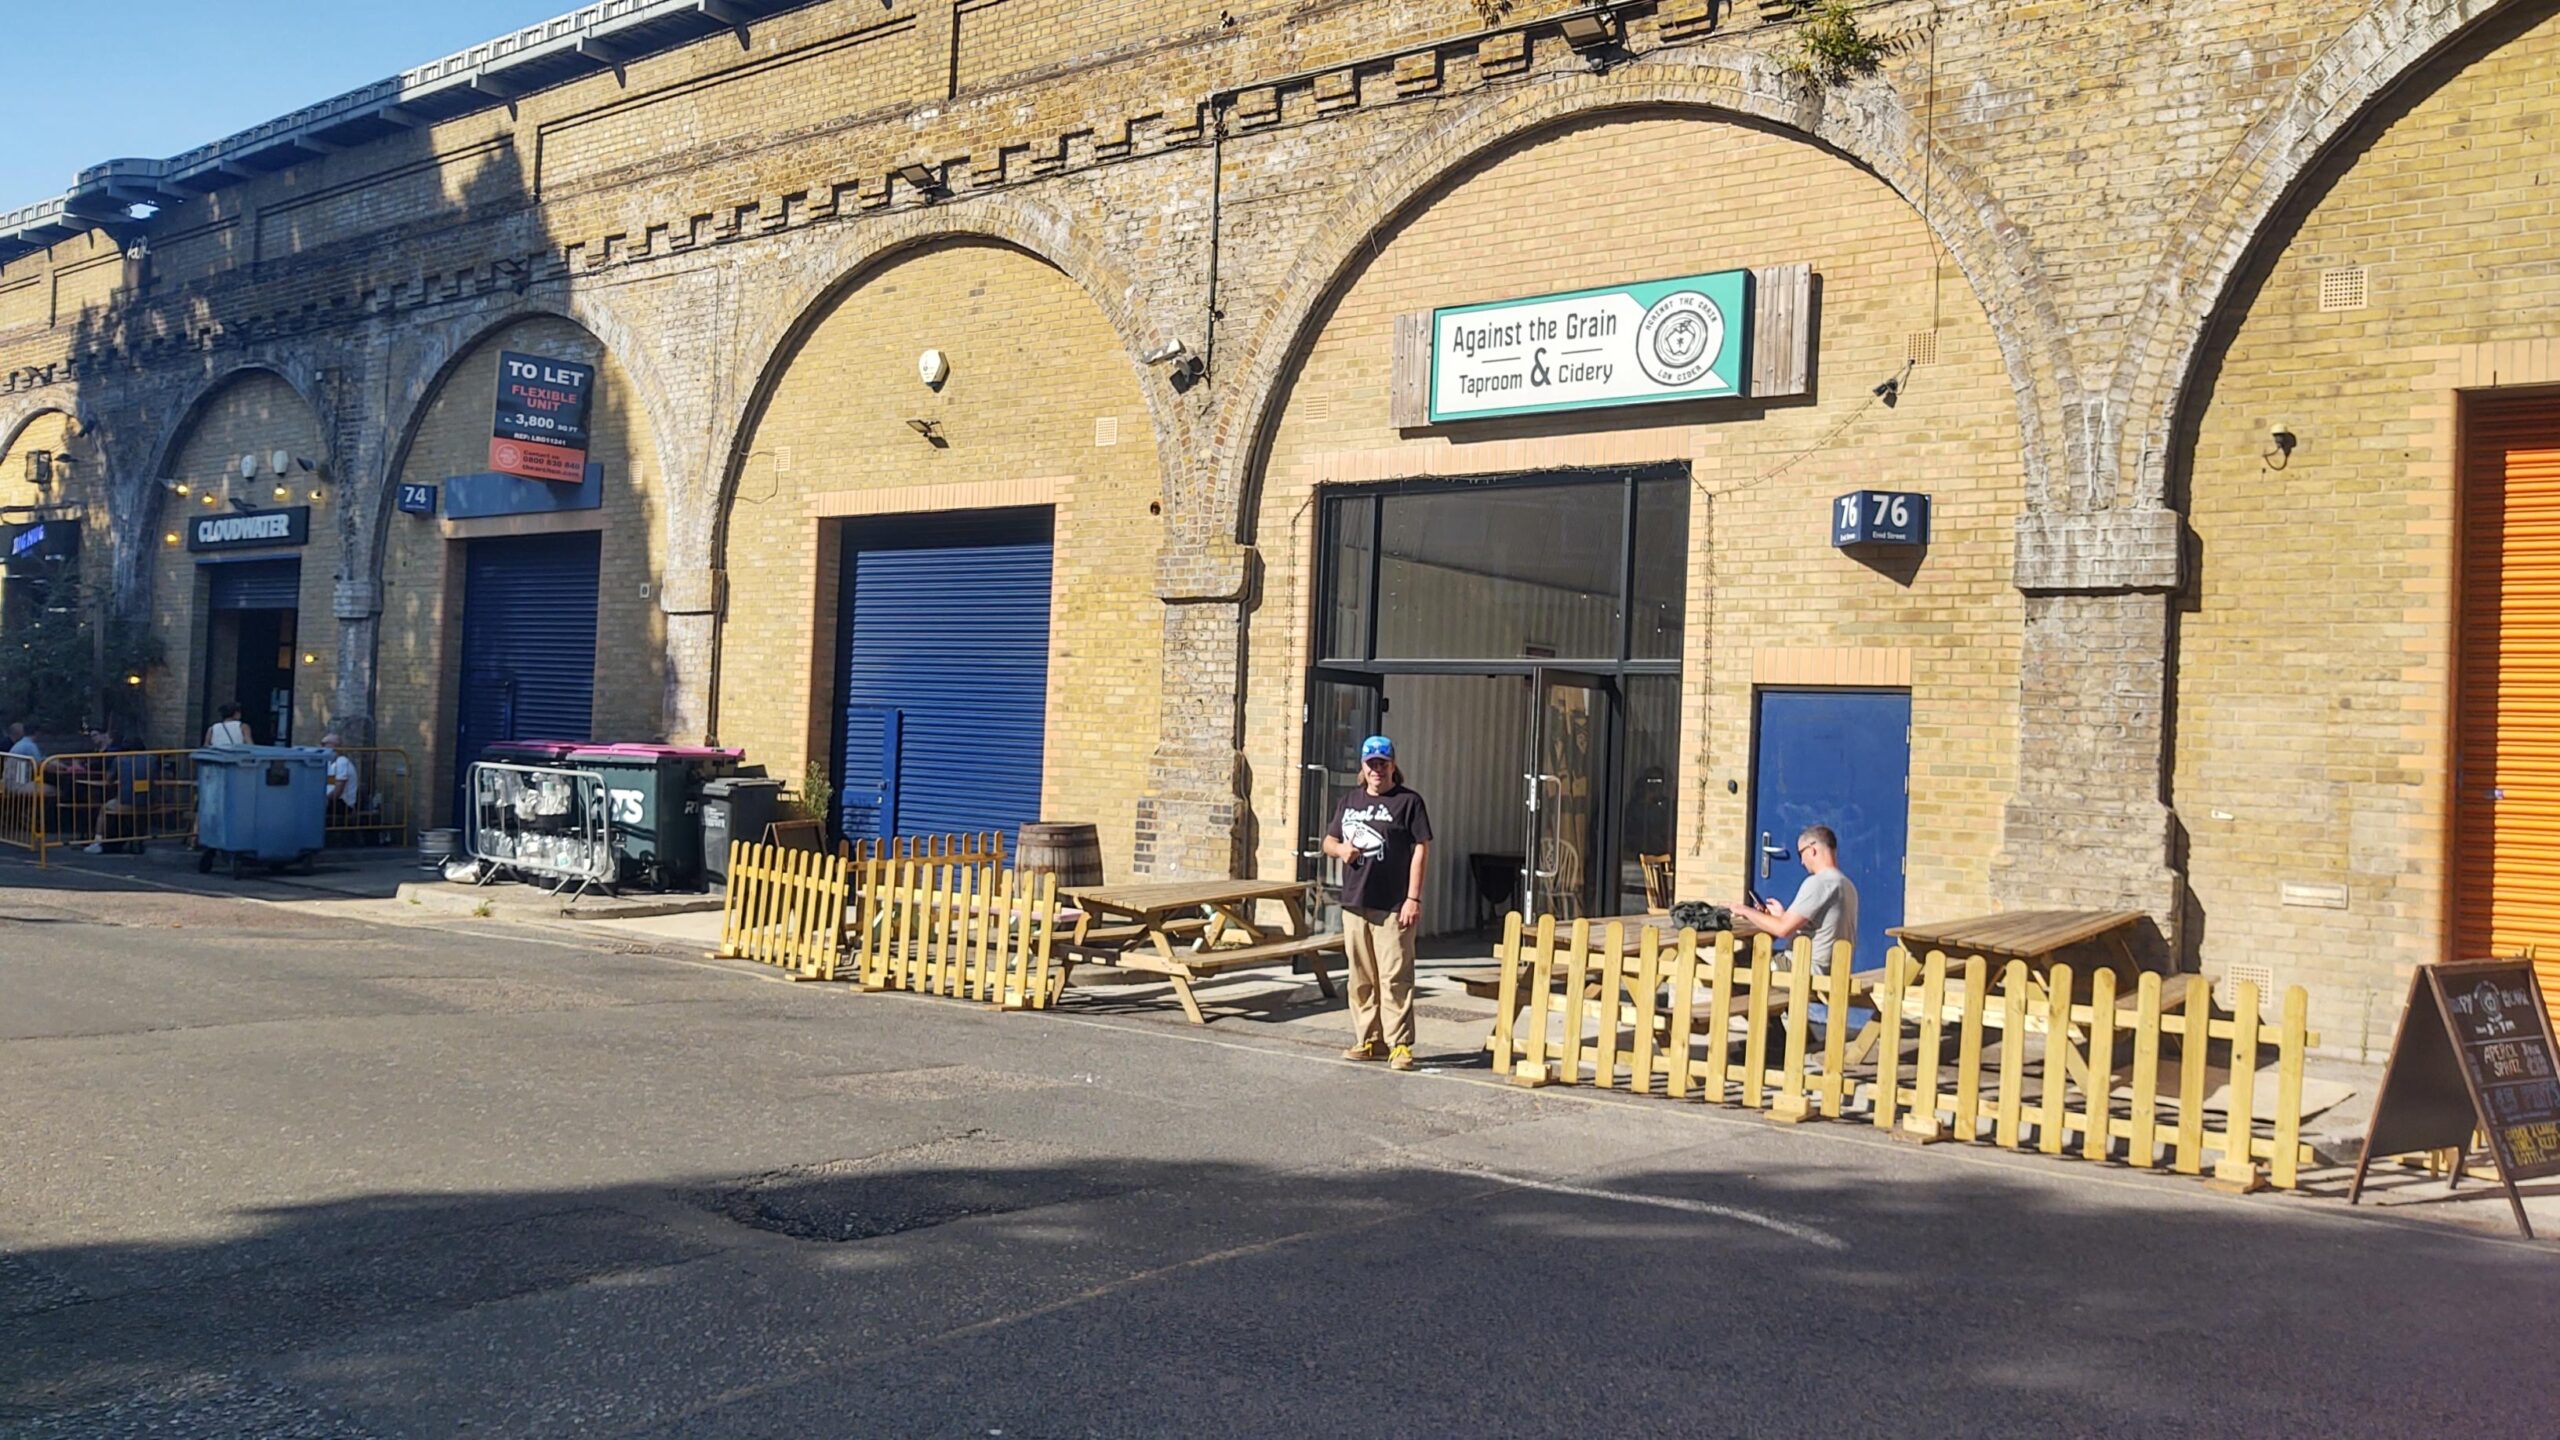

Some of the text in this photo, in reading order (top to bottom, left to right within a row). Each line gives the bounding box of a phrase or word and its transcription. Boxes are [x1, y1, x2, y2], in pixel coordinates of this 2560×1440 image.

[1453, 309, 1617, 358] Against the Grain
[508, 360, 585, 387] TO LET
[1459, 347, 1613, 398] Taproom & Cidery
[511, 384, 577, 404] FLEXIBLE
[526, 398, 561, 412] UNIT
[515, 413, 555, 430] 3,800
[404, 486, 427, 504] 74
[1840, 495, 1858, 530] 76
[1872, 494, 1909, 528] 76
[198, 513, 290, 543] CLOUDWATER
